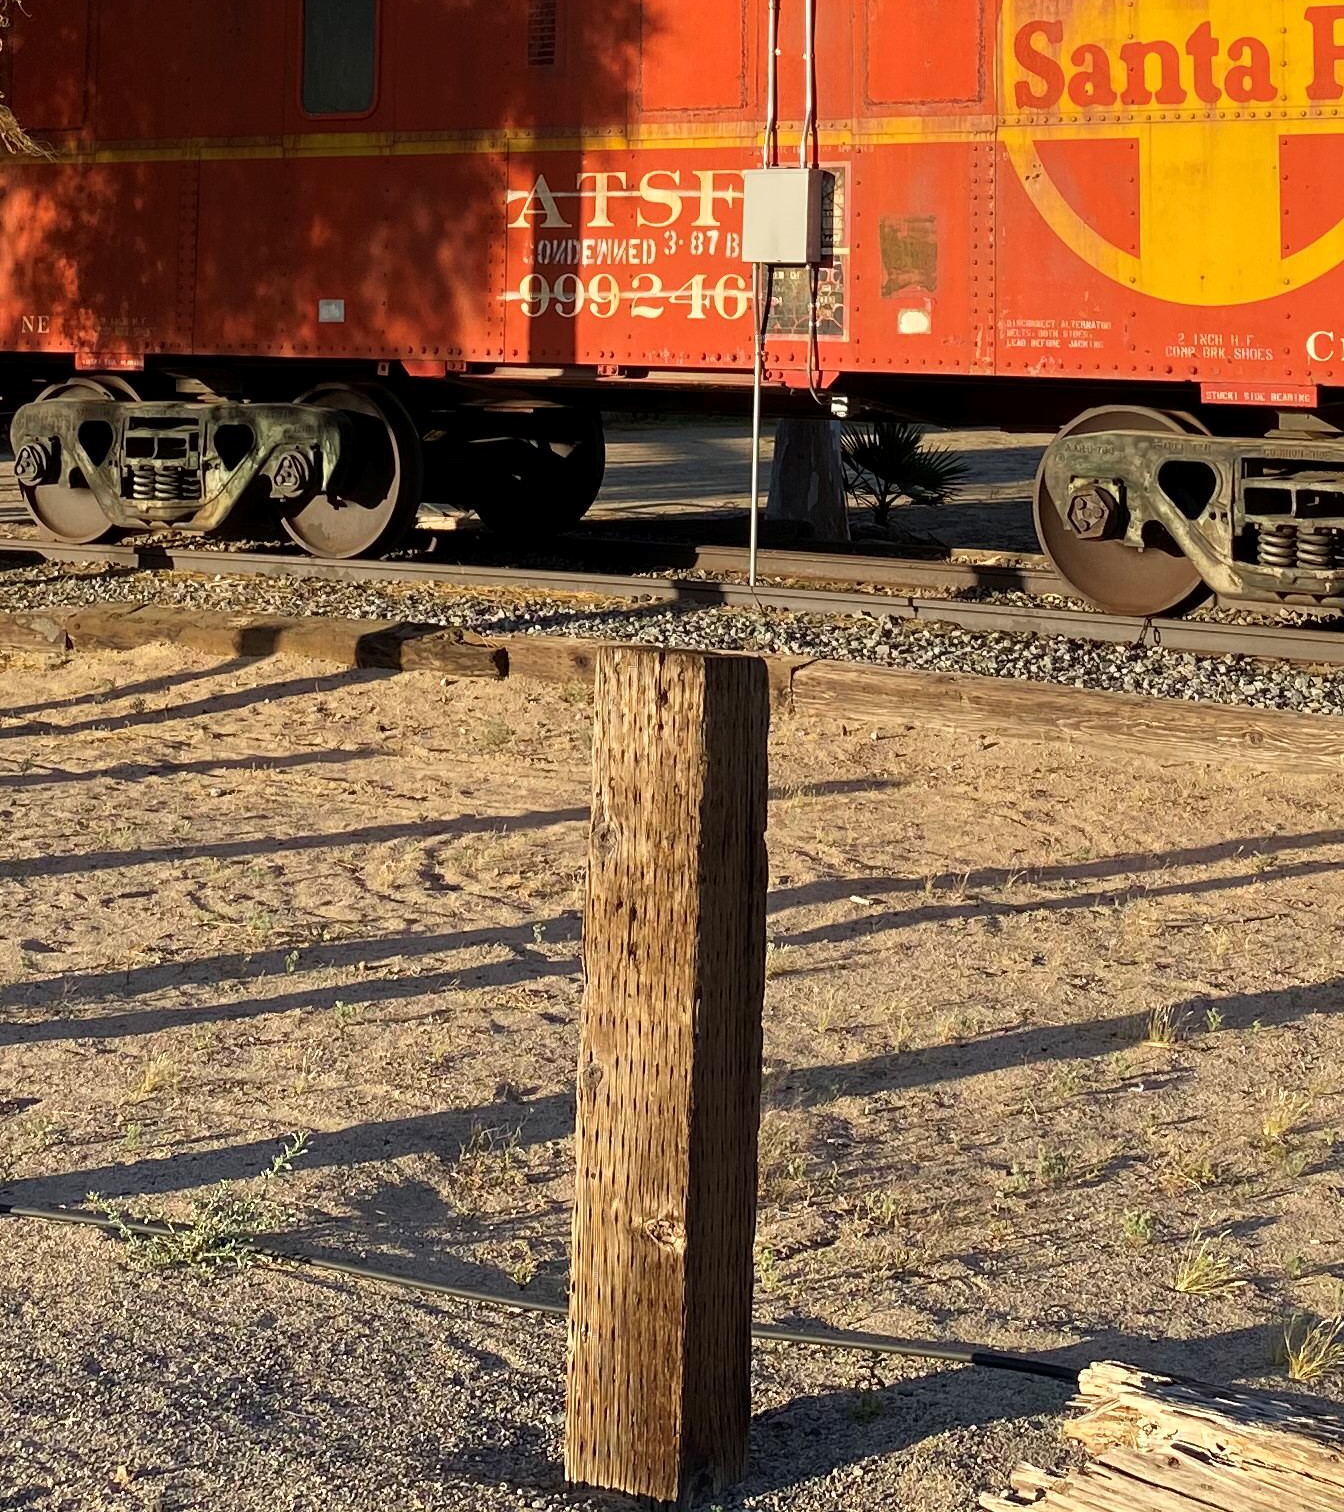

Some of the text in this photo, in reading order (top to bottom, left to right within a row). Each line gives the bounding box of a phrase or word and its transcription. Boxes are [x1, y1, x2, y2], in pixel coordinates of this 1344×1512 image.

[1013, 19, 1279, 109] Santa
[507, 169, 747, 228] ATSF
[518, 273, 749, 320] 999246
[21, 315, 50, 334] NE
[1177, 333, 1185, 346] 2
[1193, 334, 1223, 346] INCH
[1233, 348, 1274, 361] SHOES
[1243, 391, 1266, 401] SIDE
[1270, 392, 1311, 403] BEARING
